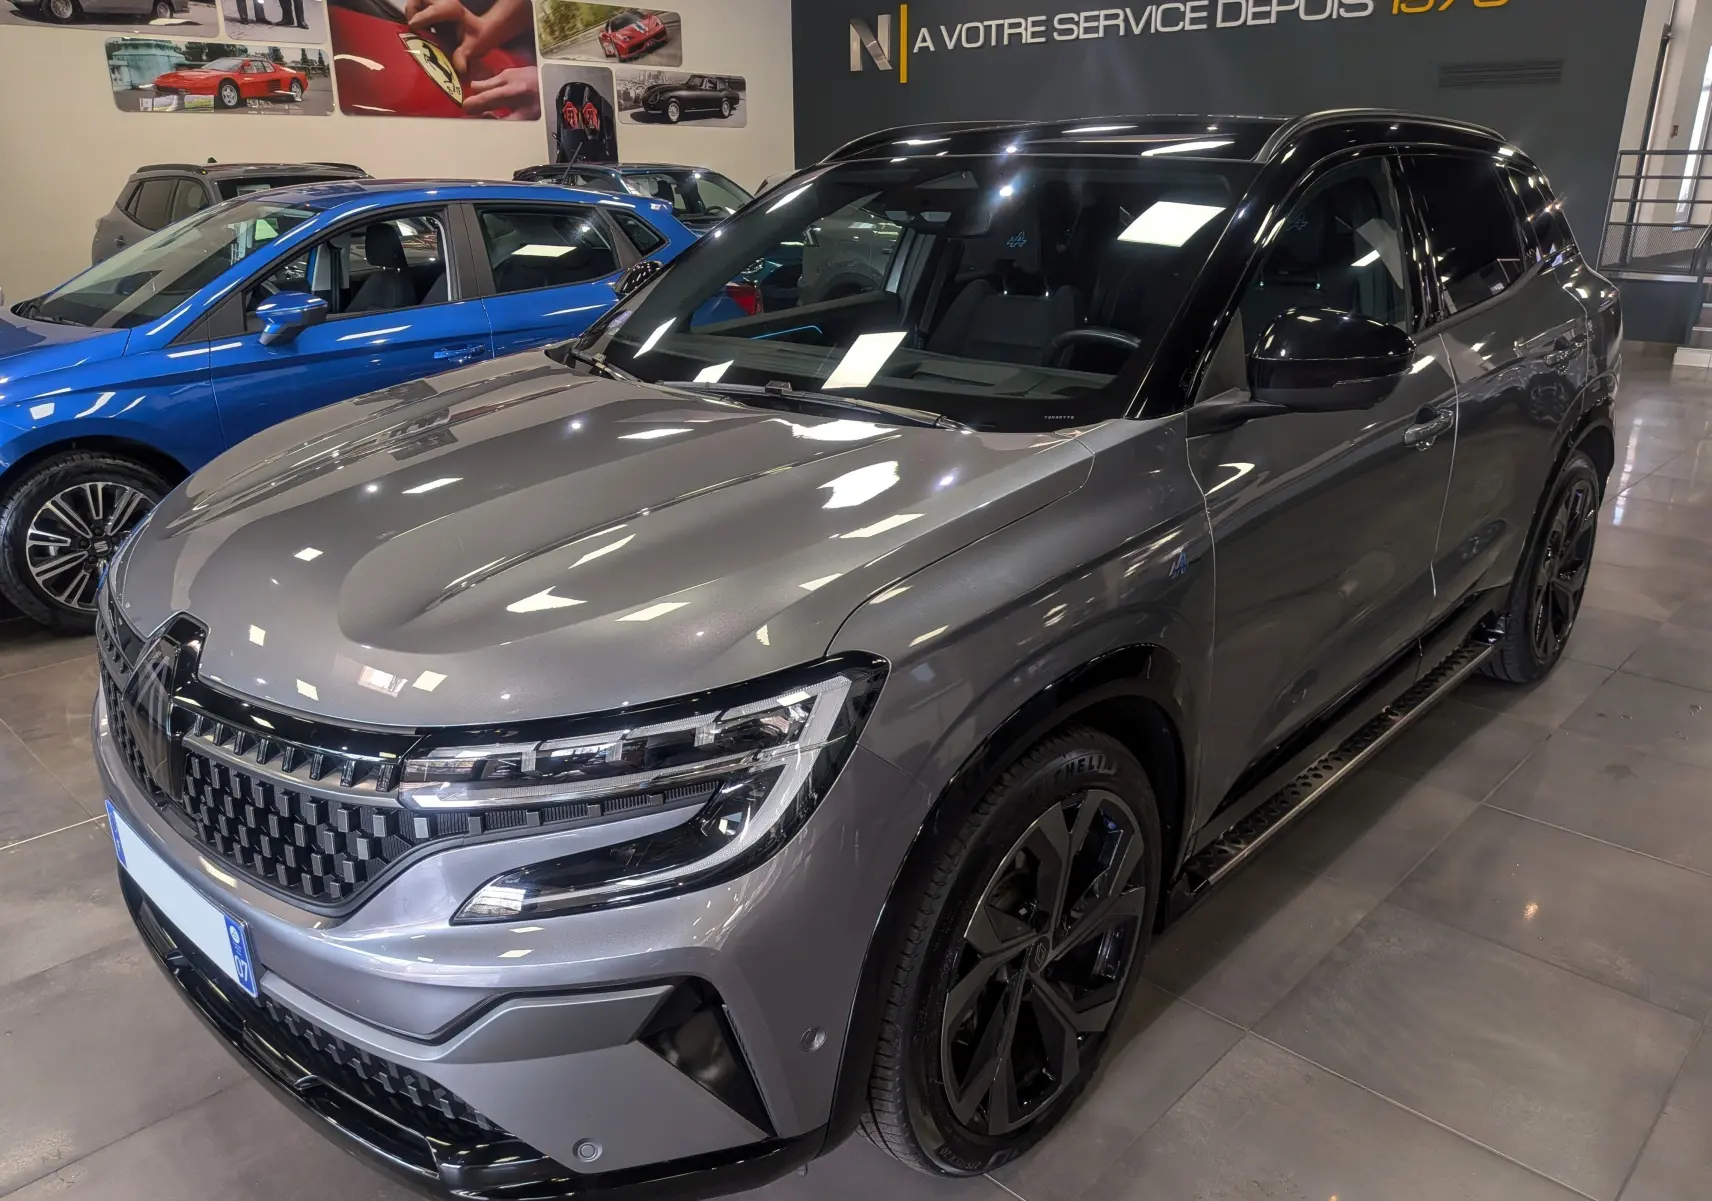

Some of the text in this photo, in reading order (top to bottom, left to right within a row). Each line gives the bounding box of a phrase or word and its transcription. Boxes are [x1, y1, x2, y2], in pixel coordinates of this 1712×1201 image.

[913, 27, 935, 53] A
[940, 15, 1047, 50] VOTRE
[1053, 1, 1208, 41] SERVICE
[1216, 0, 1374, 27] DEPUIS
